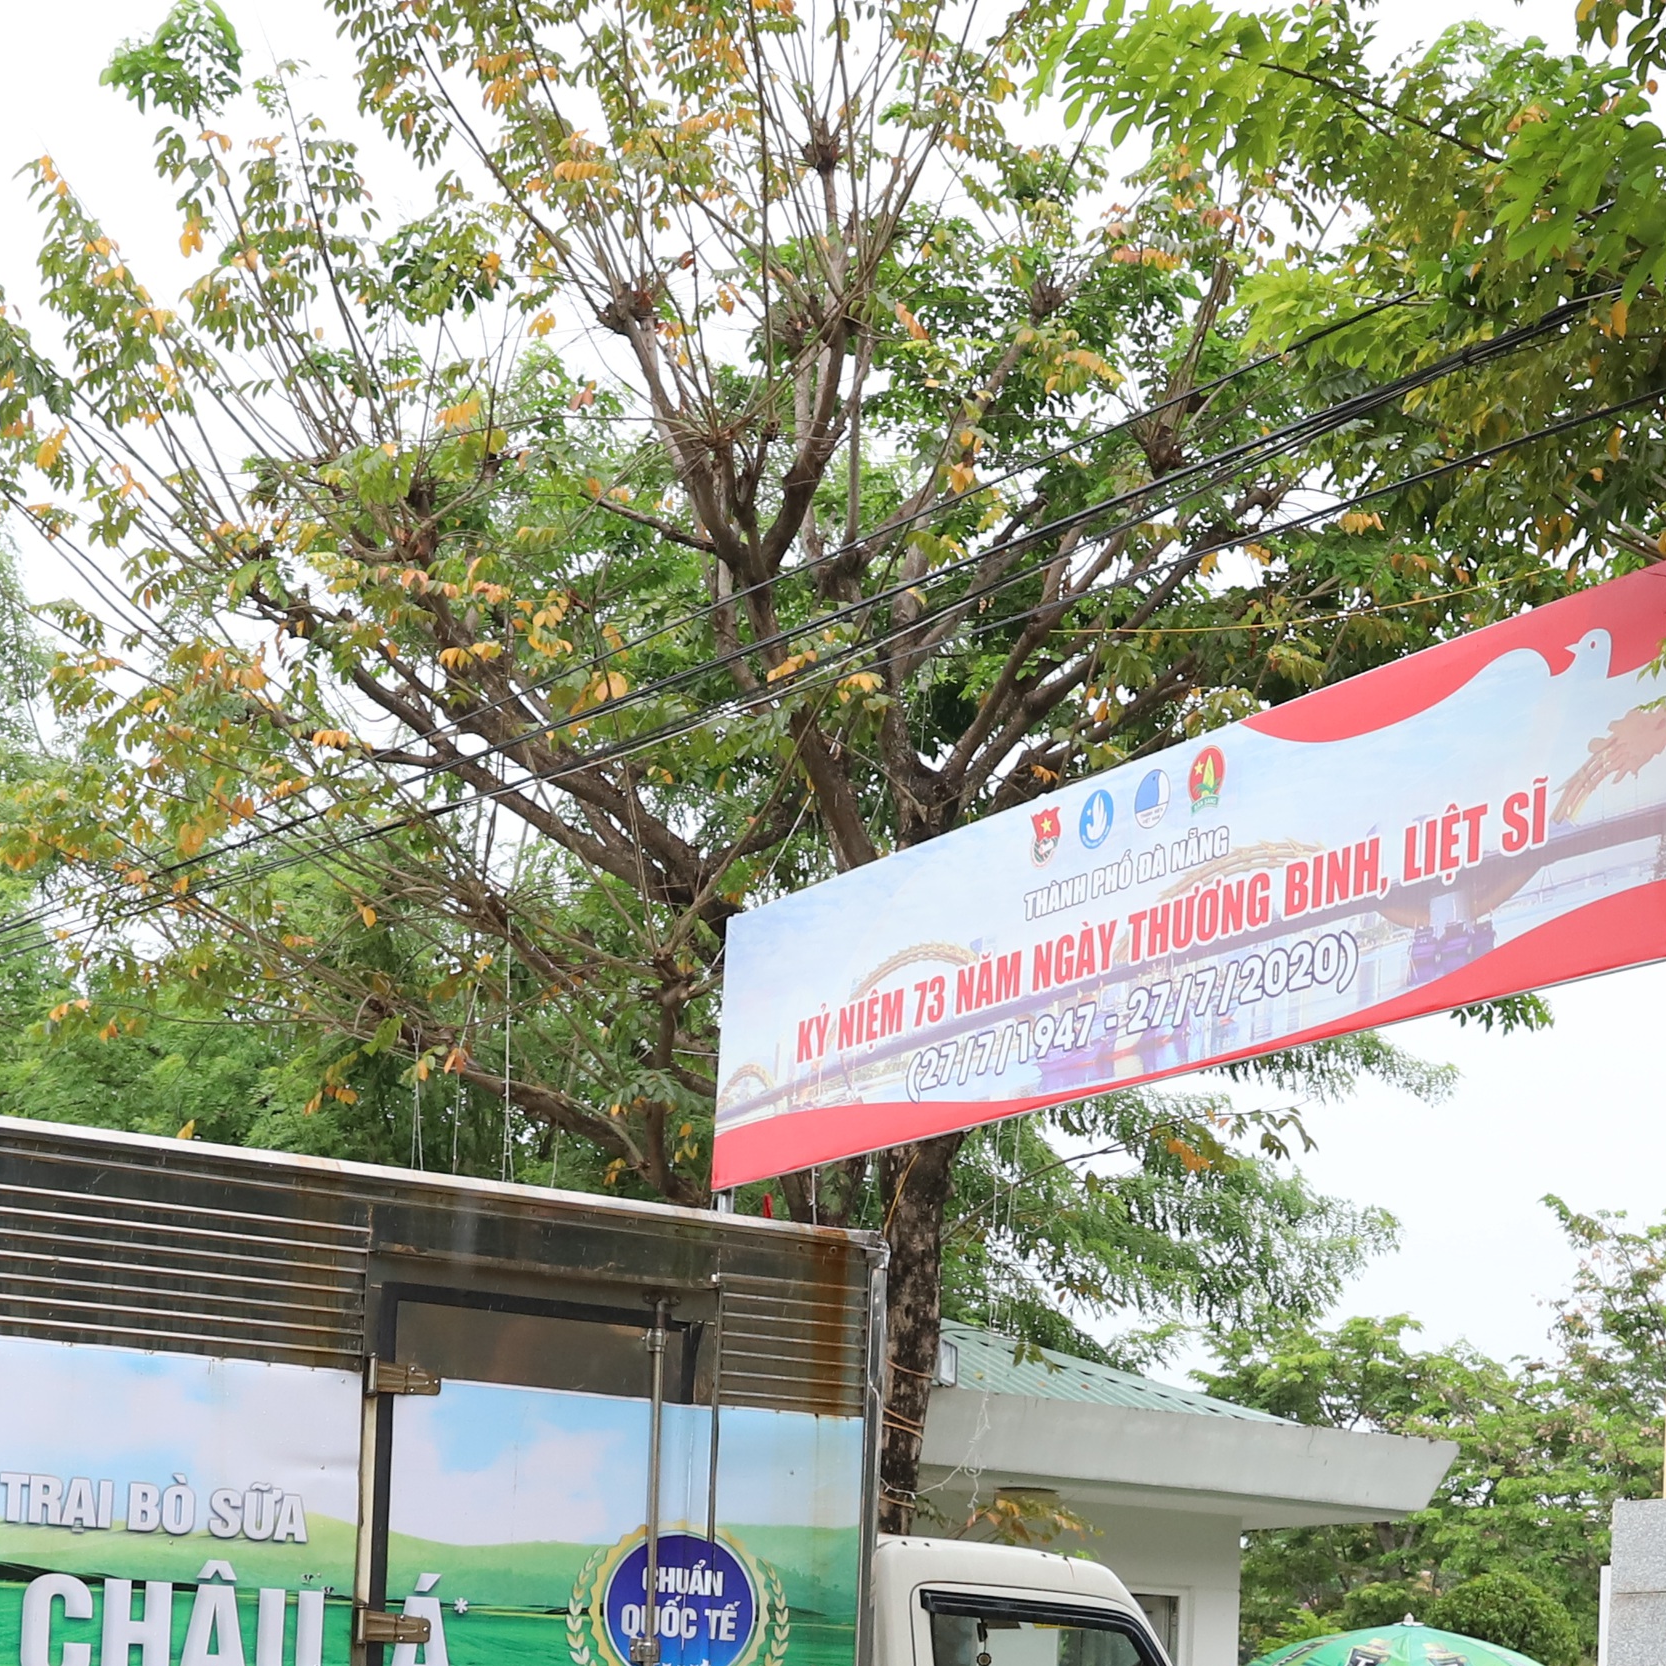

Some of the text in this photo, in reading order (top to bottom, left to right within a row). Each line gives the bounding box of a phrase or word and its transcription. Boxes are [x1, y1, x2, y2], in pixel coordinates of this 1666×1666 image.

[796, 776, 1550, 1064] KỶ NIỆM 73 NĂM NGÀY THƯƠNG BINH, LIỆT SĨ
[1024, 873, 1088, 922] THÀNH
[1091, 848, 1133, 899] PHỐ
[1137, 844, 1167, 884] ĐÀ
[1170, 826, 1230, 873] NẴNG
[906, 1001, 1097, 1103] (27/7/1947
[1127, 930, 1360, 1034] 27/7/2020)
[0, 1471, 113, 1534] TRẠI
[127, 1473, 195, 1535] BÒ
[208, 1482, 309, 1544] SỮA
[621, 1596, 741, 1642] QUỐC TẾ
